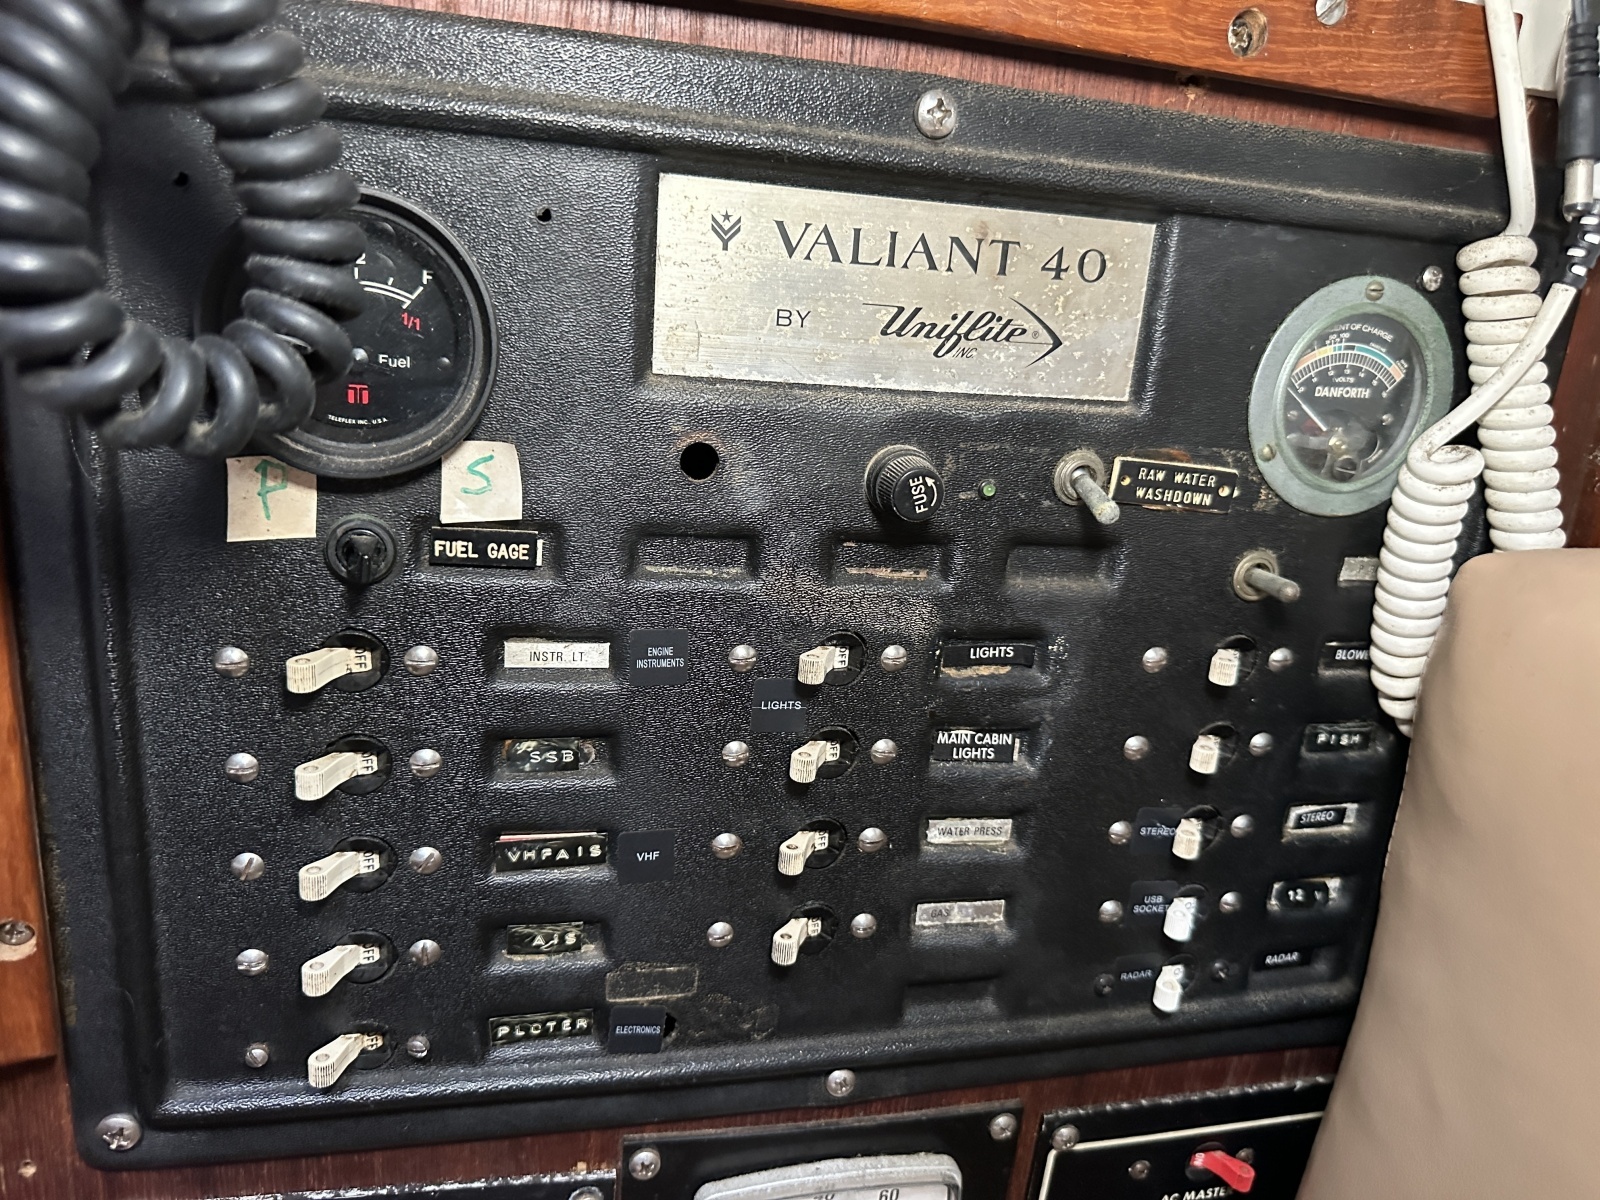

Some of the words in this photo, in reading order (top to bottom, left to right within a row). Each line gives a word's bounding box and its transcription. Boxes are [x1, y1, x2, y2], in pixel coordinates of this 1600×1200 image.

[774, 219, 1022, 277] VALIANT
[1041, 248, 1108, 284] 40
[422, 269, 434, 285] F
[776, 308, 811, 329] BY
[863, 302, 1028, 359] Uniflite
[1351, 323, 1362, 331] OF
[1361, 323, 1394, 343] CHARGE
[378, 353, 411, 369] Fuel
[1314, 386, 1371, 399] DANFORTH
[459, 453, 495, 496] S
[1138, 467, 1166, 482] RAW
[1173, 471, 1217, 489] WATER
[910, 475, 929, 514] FUSE
[1135, 486, 1213, 507] WASHDOWN
[434, 539, 479, 559] FUEL
[487, 542, 530, 561] GAGE
[647, 647, 674, 657] ENGINE
[970, 646, 1015, 660] LIGHTS
[1335, 649, 1370, 661] BLOWE
[636, 658, 685, 668] INSTRUMENTS
[761, 700, 802, 711] LIGHTS
[937, 731, 972, 745] MAIN
[974, 733, 1012, 746] CABIN
[530, 749, 574, 764] SSB
[952, 747, 995, 760] LIGHTS
[1299, 810, 1335, 824] STEREO
[937, 827, 970, 837] WATER
[974, 826, 1003, 837] PRESS
[1139, 826, 1176, 836] STEREO
[636, 851, 660, 862] VHF
[1144, 895, 1163, 905] USB
[1265, 951, 1300, 965] RADAR
[1120, 970, 1152, 981] RADAR
[615, 1025, 661, 1035] ELECTRONICS
